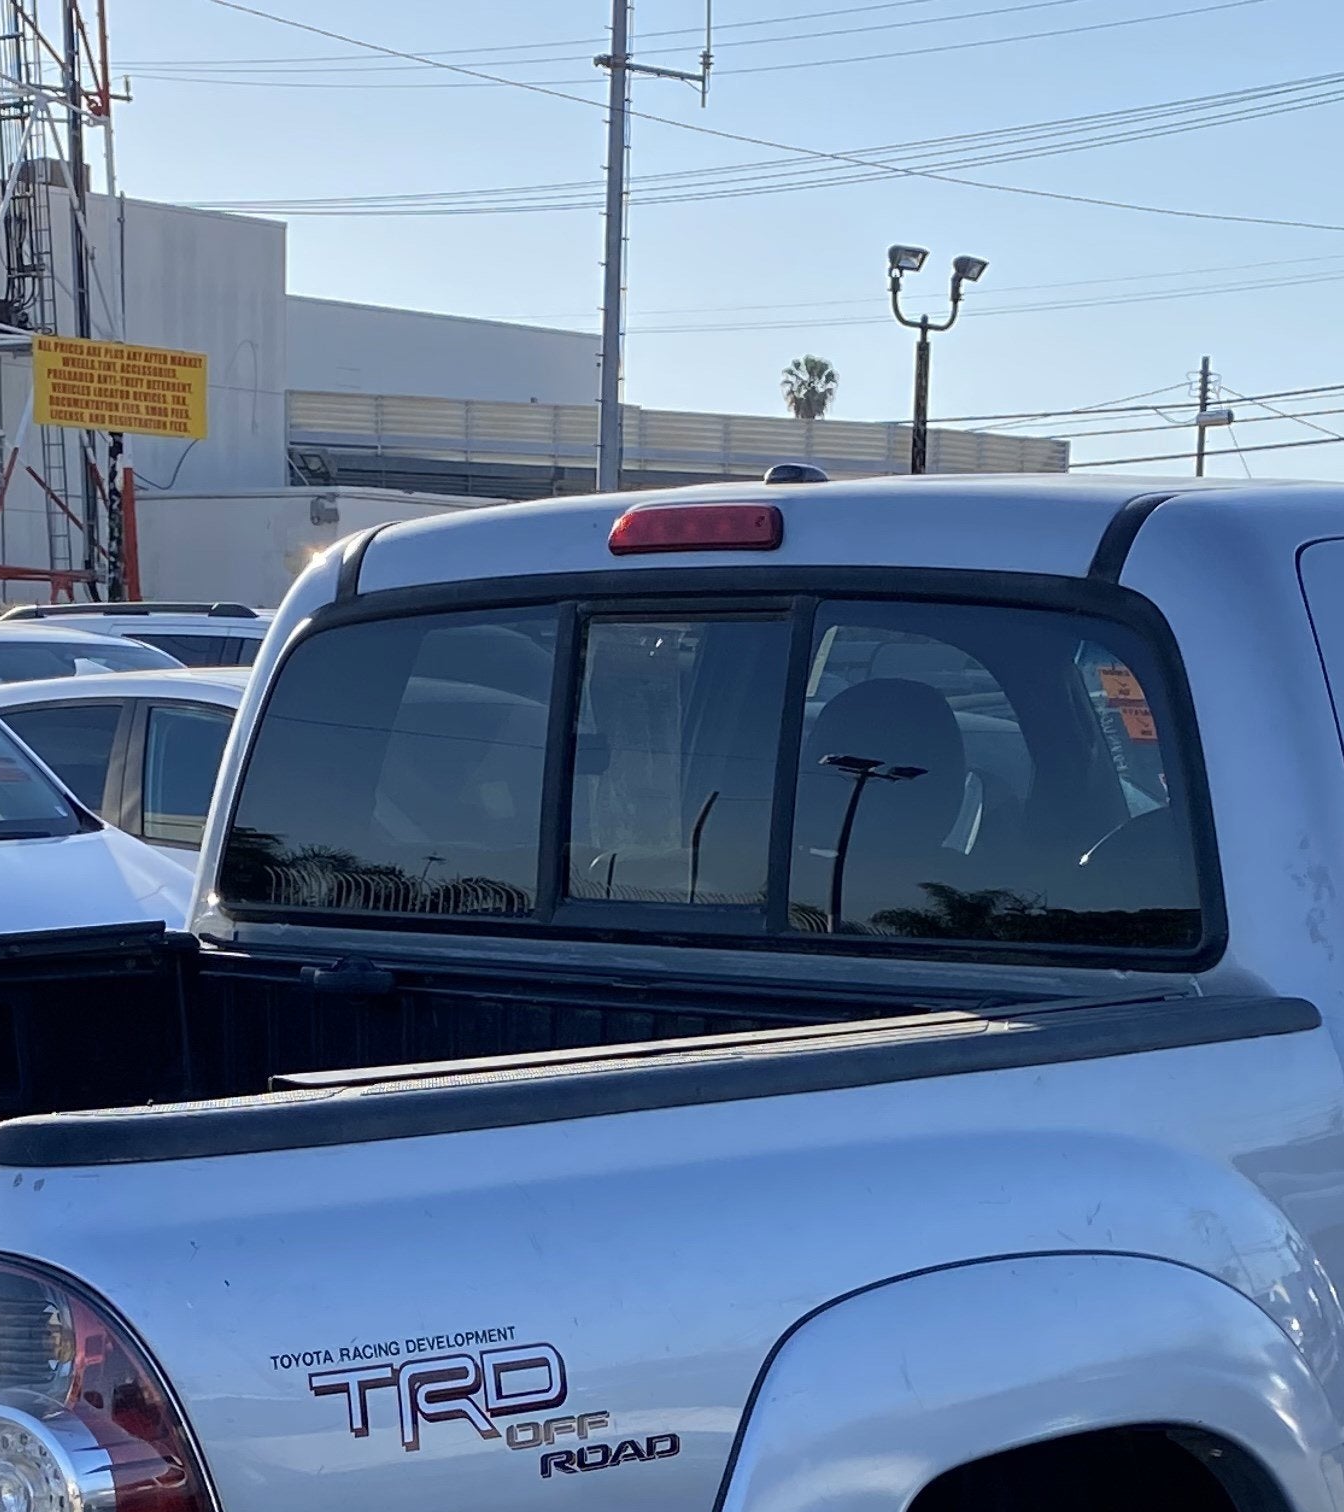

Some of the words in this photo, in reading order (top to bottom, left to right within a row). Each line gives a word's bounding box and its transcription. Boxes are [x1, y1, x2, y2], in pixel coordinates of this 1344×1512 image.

[38, 339, 51, 352] ALL
[54, 341, 84, 356] PRICES
[86, 346, 102, 358] ARE
[104, 347, 125, 361] PLUS
[127, 350, 143, 362] ANY
[144, 352, 168, 365] AFTER
[170, 355, 203, 369] MARKET
[47, 368, 95, 384] PRELOADED
[98, 373, 144, 389] ANTI-THEFT
[51, 381, 91, 397] VEHICLES
[94, 386, 130, 400] LOCATOR
[49, 394, 119, 412] DOCUMENTATION
[144, 404, 169, 418] SMOG
[89, 413, 106, 425] AND
[108, 414, 167, 430] REGISTRATION
[269, 1349, 334, 1371] TOYOTA
[339, 1340, 401, 1363] RACING
[404, 1326, 516, 1354] DEVELOPMENT
[307, 1341, 568, 1452] TRD
[506, 1410, 610, 1450] OFF
[539, 1432, 681, 1479] ROAD
